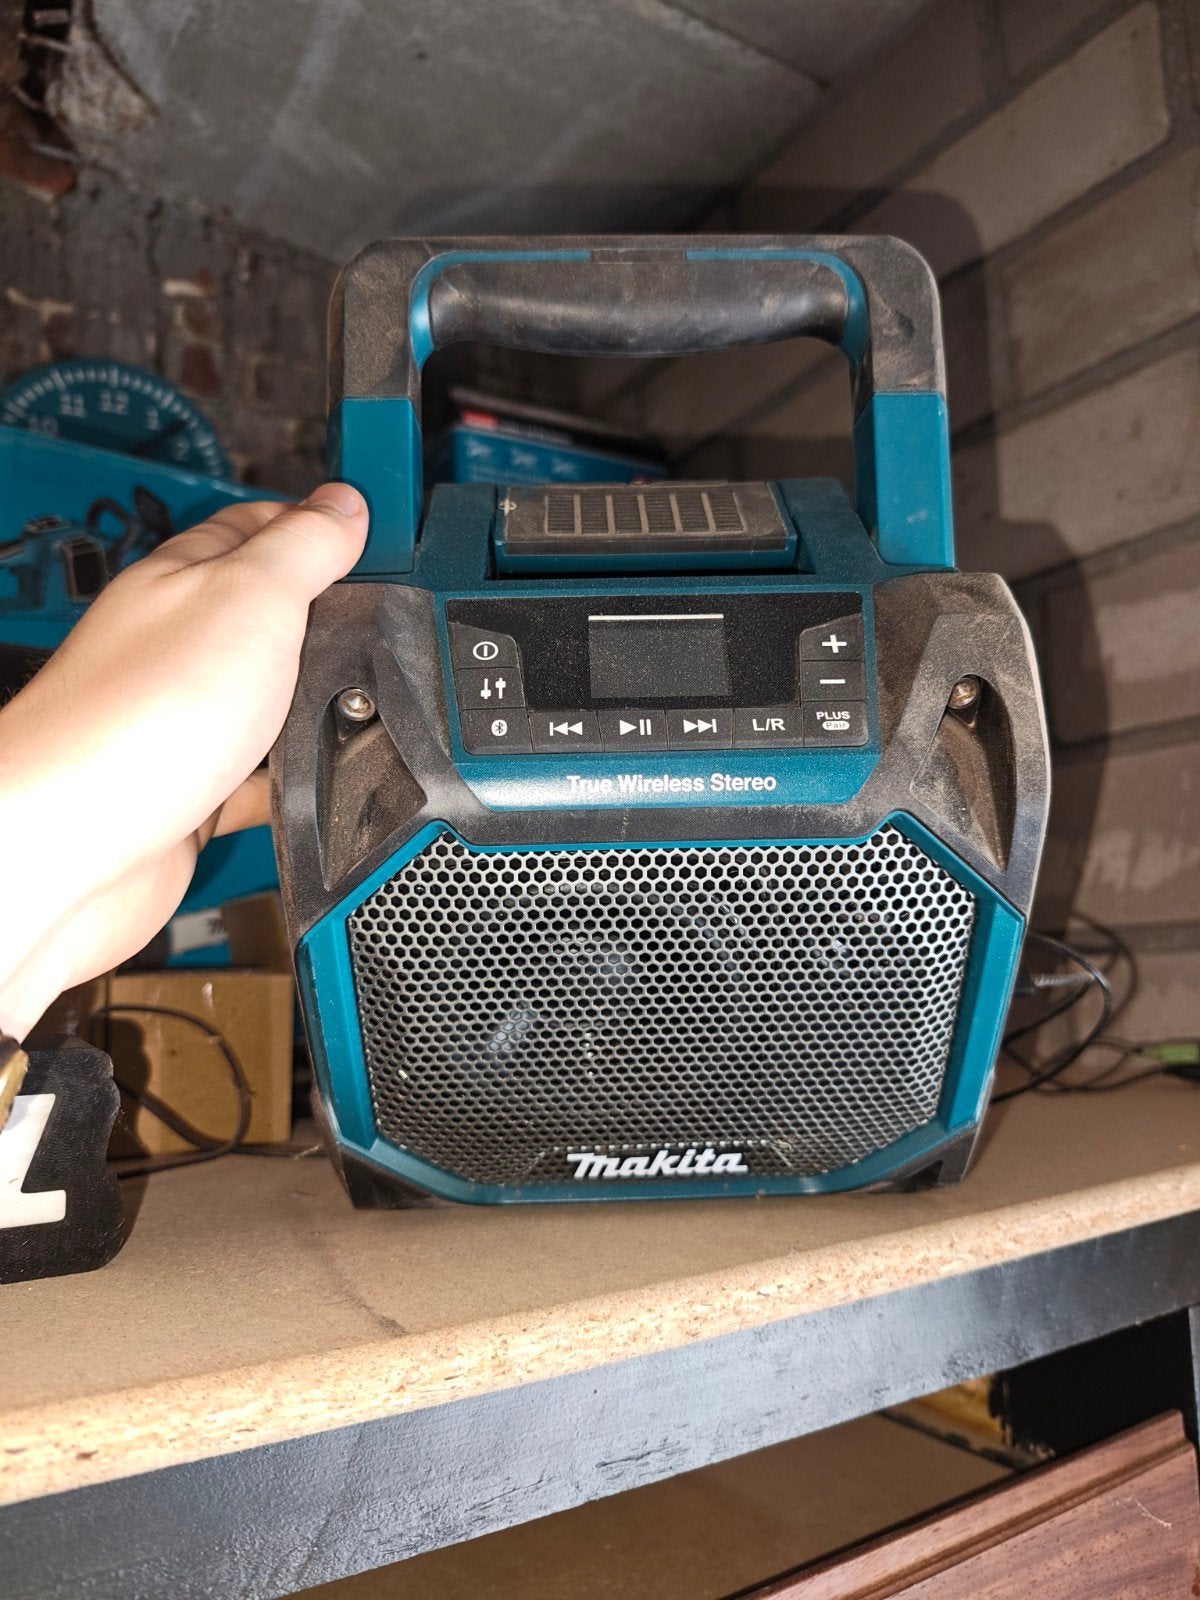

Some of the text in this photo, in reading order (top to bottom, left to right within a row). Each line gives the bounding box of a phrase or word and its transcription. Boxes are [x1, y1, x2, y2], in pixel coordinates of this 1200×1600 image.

[816, 711, 851, 721] PLUS
[752, 717, 786, 732] L/R
[826, 722, 847, 730] Pair
[567, 773, 777, 794] True Wireless Stereo
[566, 1148, 749, 1178] Makita
